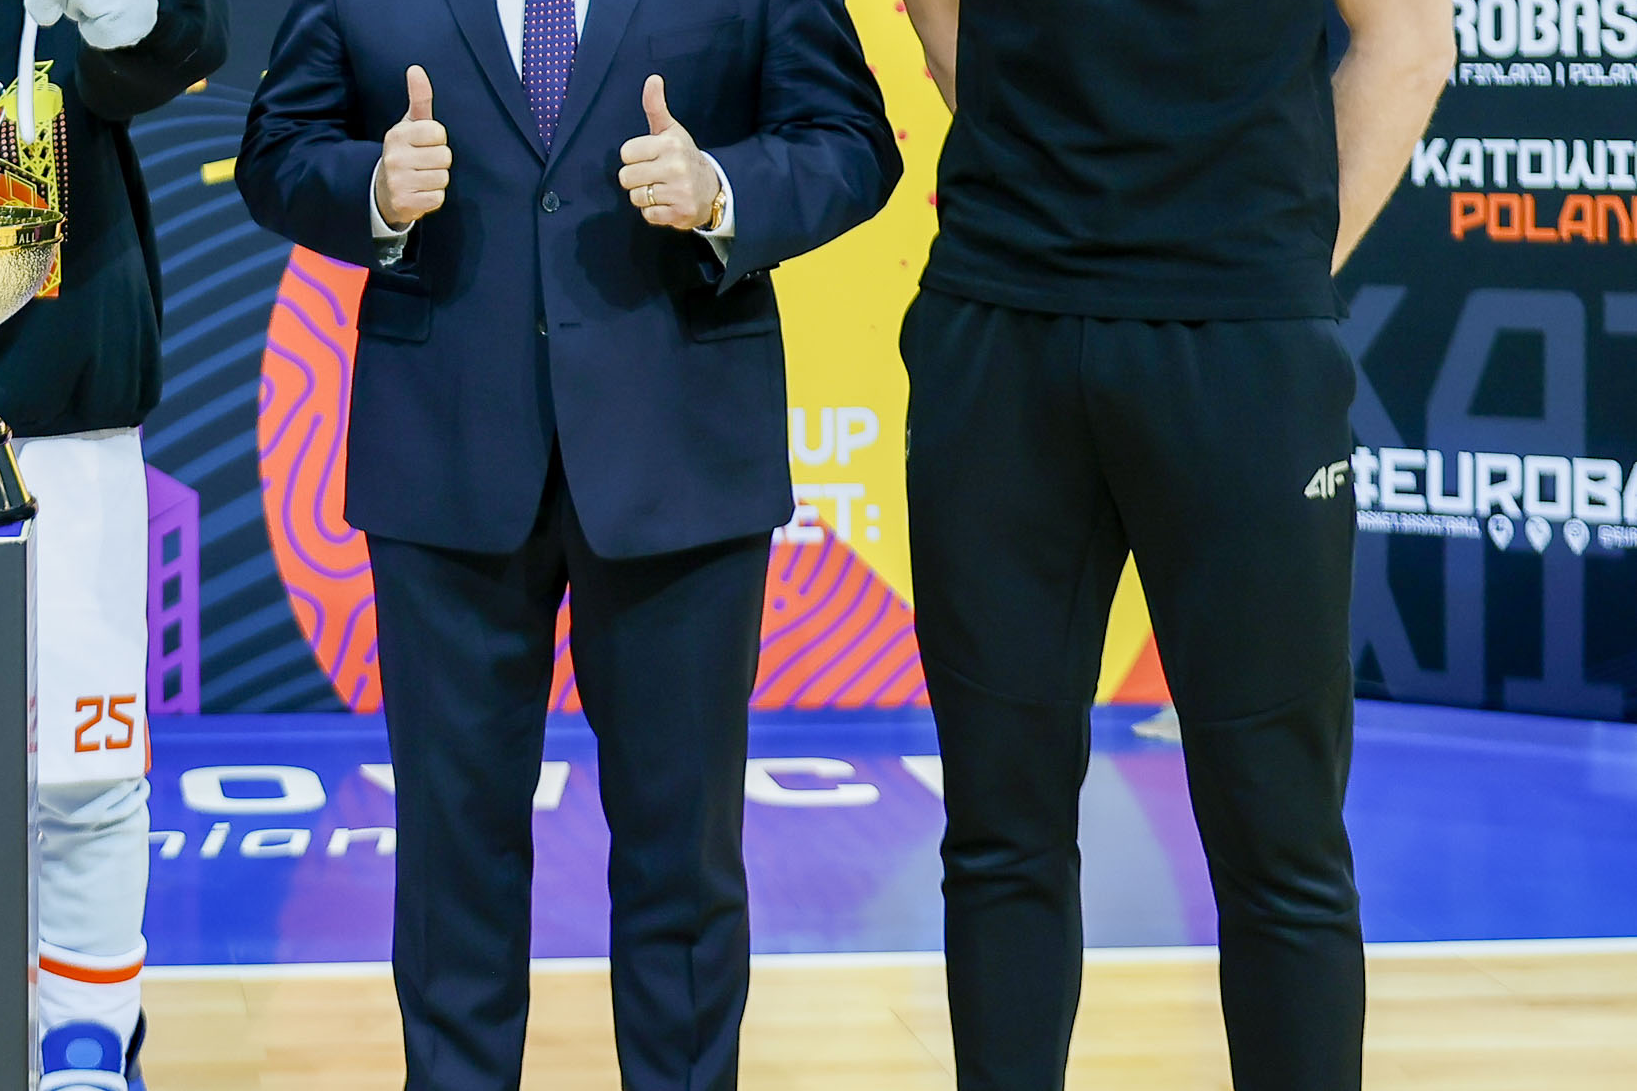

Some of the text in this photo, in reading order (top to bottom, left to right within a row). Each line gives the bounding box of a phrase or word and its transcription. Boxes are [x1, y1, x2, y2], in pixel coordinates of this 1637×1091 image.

[1459, 62, 1553, 87] FINLAND
[1410, 137, 1637, 191] KATOWI
[1450, 192, 1637, 244] POLAN
[1304, 459, 1350, 500] 4F
[773, 483, 881, 543] ET:
[74, 694, 137, 753] 25
